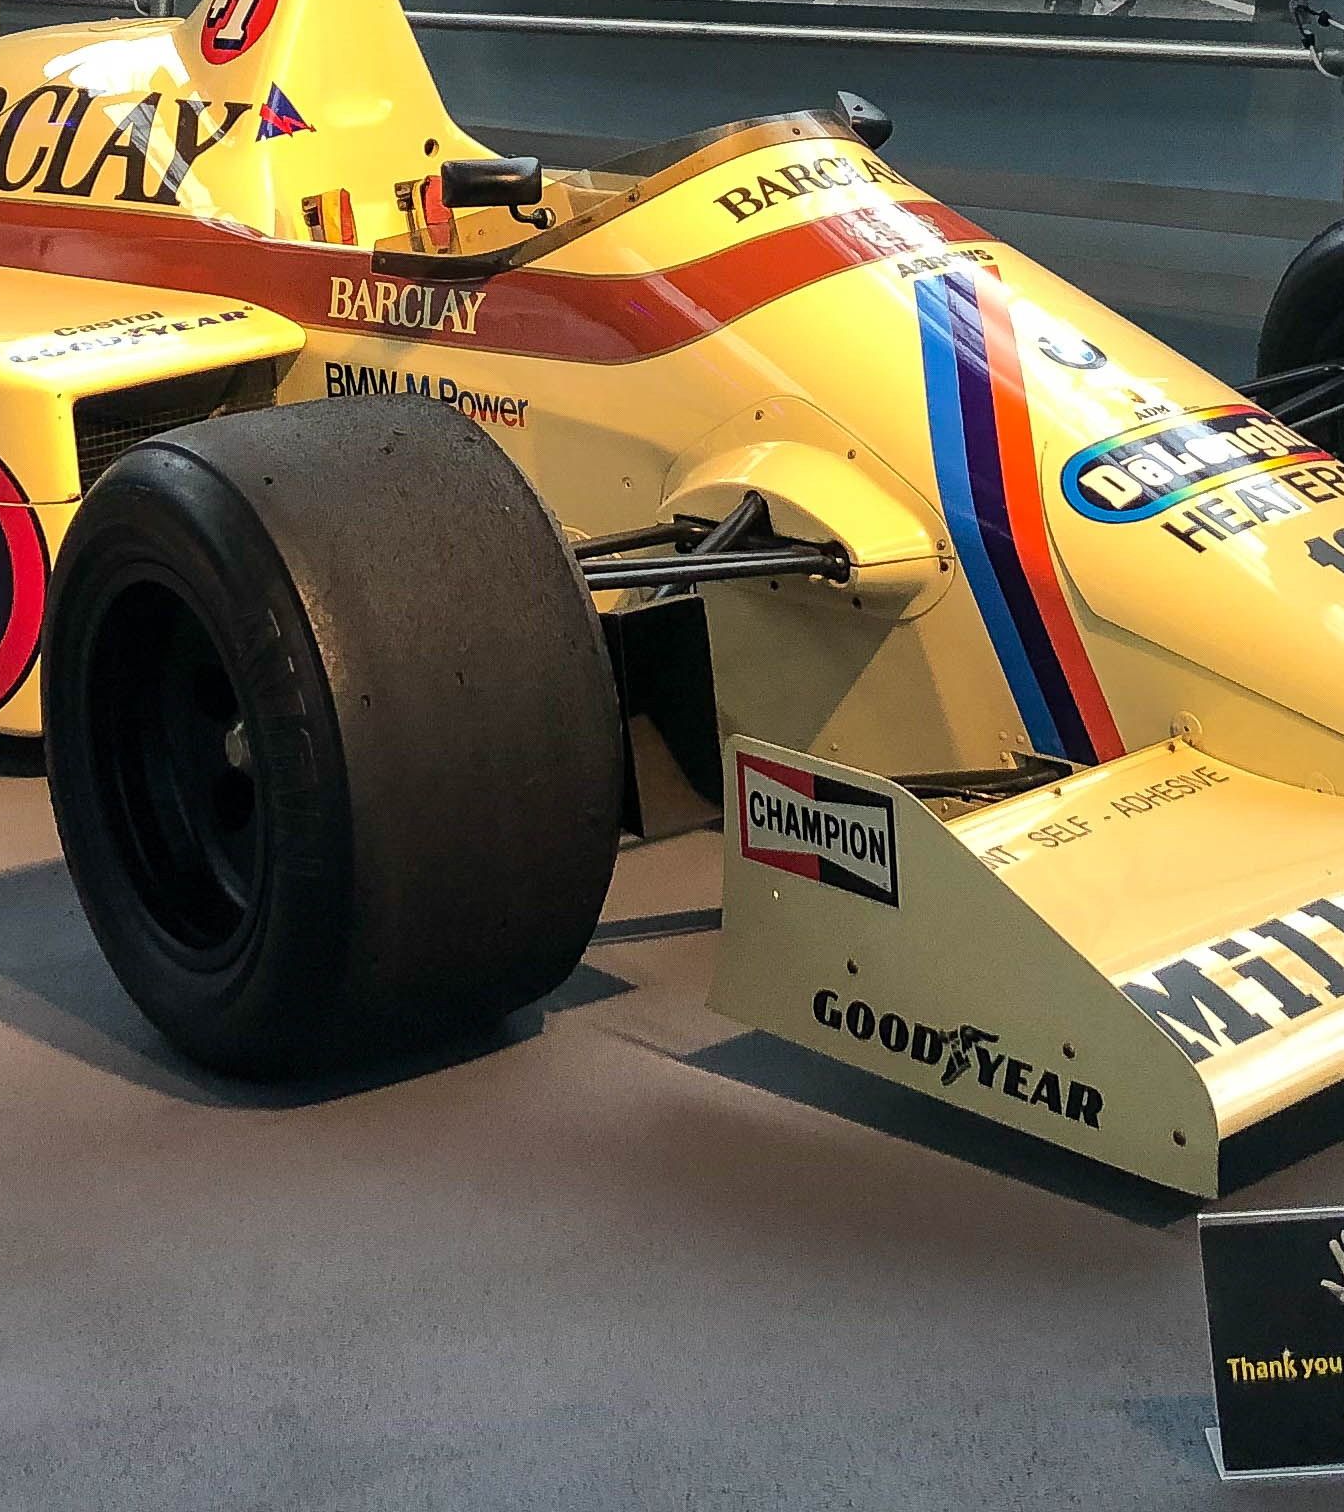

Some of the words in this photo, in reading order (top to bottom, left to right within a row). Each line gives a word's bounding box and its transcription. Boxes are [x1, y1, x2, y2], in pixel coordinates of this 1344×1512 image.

[896, 249, 994, 279] ARROWS
[53, 310, 165, 337] Castrol
[328, 276, 487, 335] BARCLAY
[324, 361, 398, 398] BMW
[406, 373, 430, 398] M
[438, 376, 529, 428] Power
[749, 790, 887, 868] CHAMPION
[1027, 815, 1093, 848] SELF
[1112, 766, 1230, 819] ADHESIVE
[1227, 1351, 1298, 1383] Thank
[1302, 1355, 1343, 1379] you
